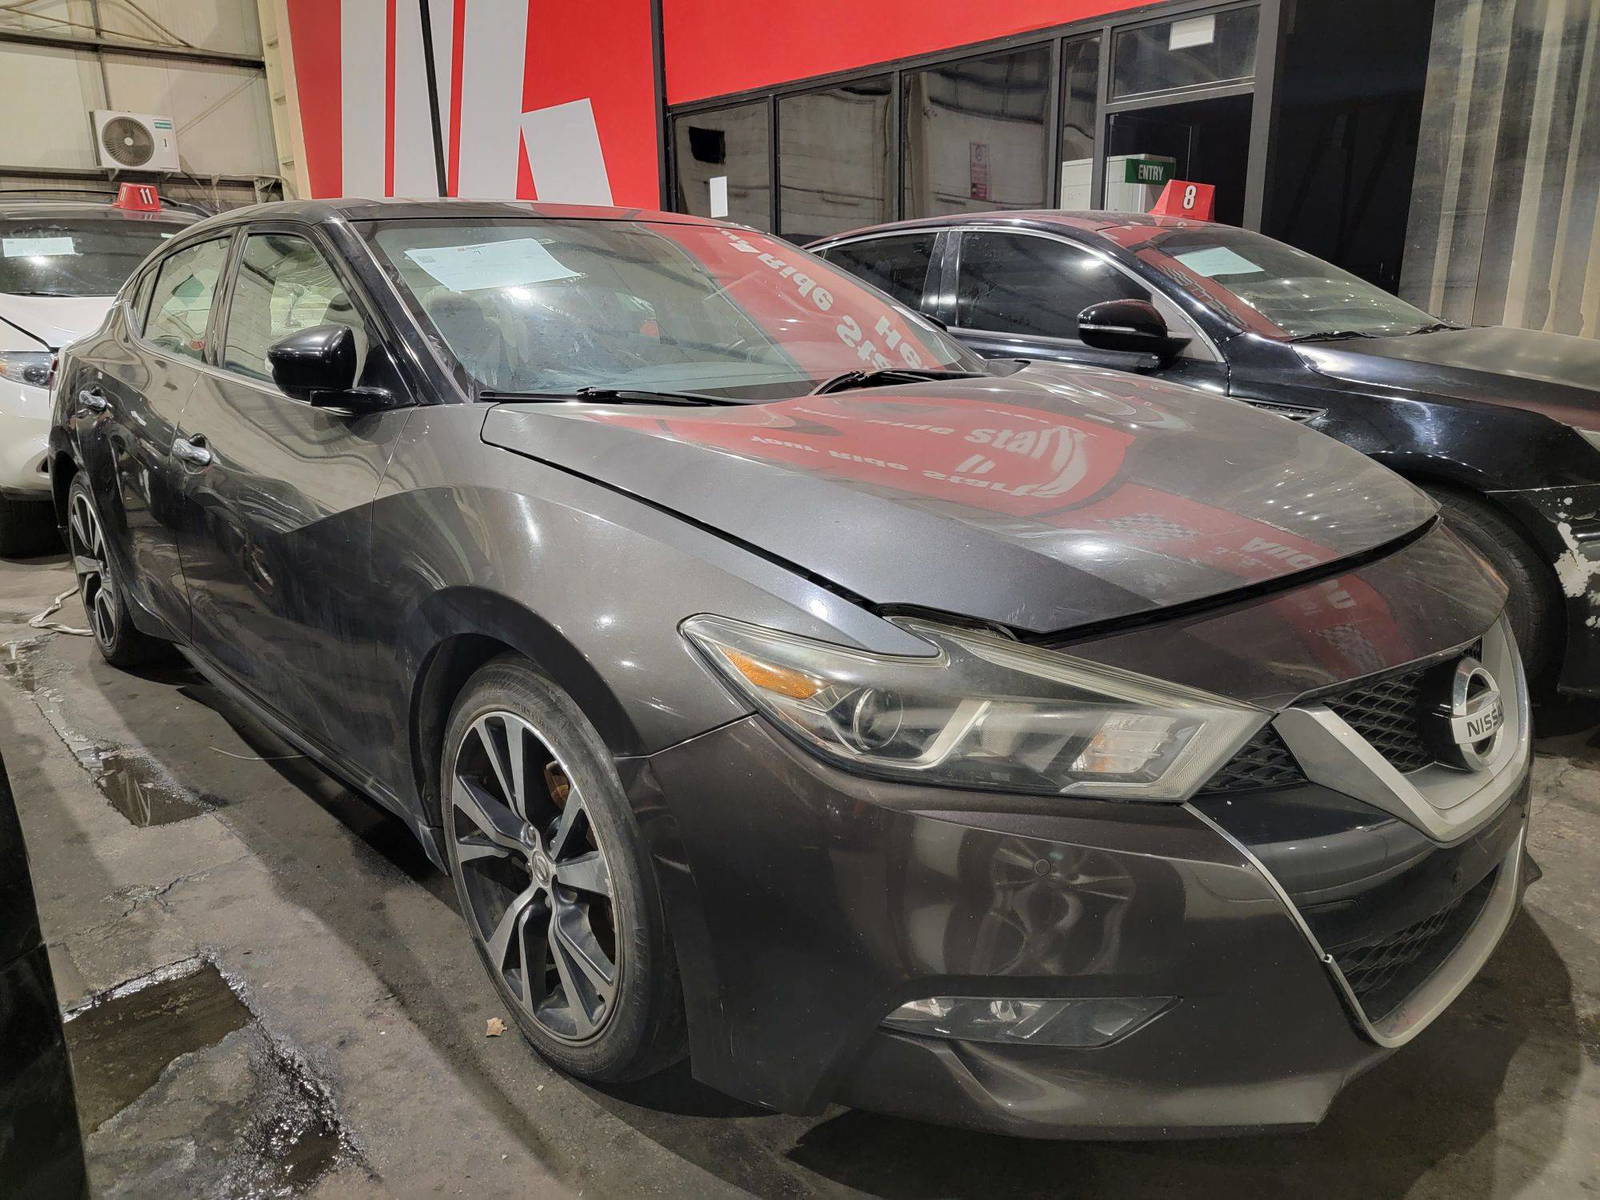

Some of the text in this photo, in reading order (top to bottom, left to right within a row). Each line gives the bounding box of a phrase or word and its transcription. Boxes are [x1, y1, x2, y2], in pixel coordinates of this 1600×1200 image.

[1138, 164, 1165, 181] ENTRY
[140, 187, 153, 205] 11
[1183, 185, 1197, 210] 8
